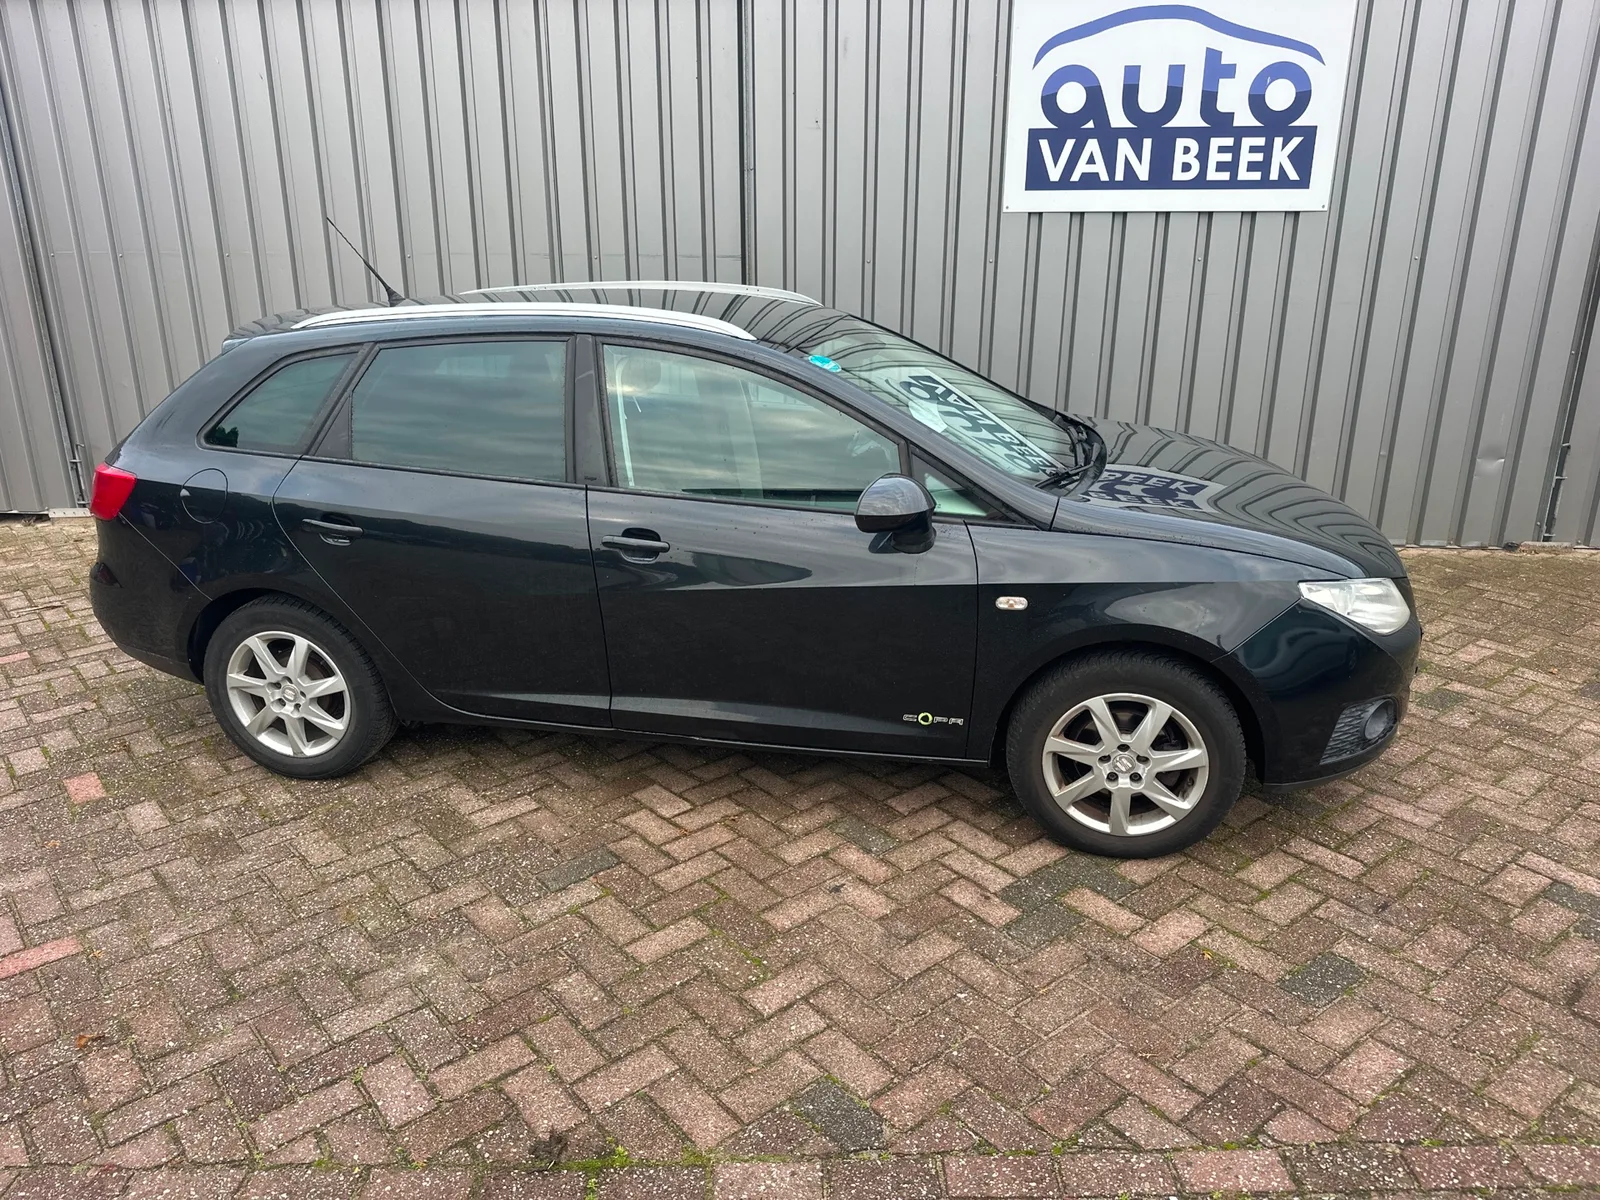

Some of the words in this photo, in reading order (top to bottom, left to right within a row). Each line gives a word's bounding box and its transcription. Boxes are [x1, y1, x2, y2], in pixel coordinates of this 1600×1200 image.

[1040, 47, 1312, 128] auto
[1038, 138, 1152, 182] VAN
[1171, 137, 1304, 181] BEEK
